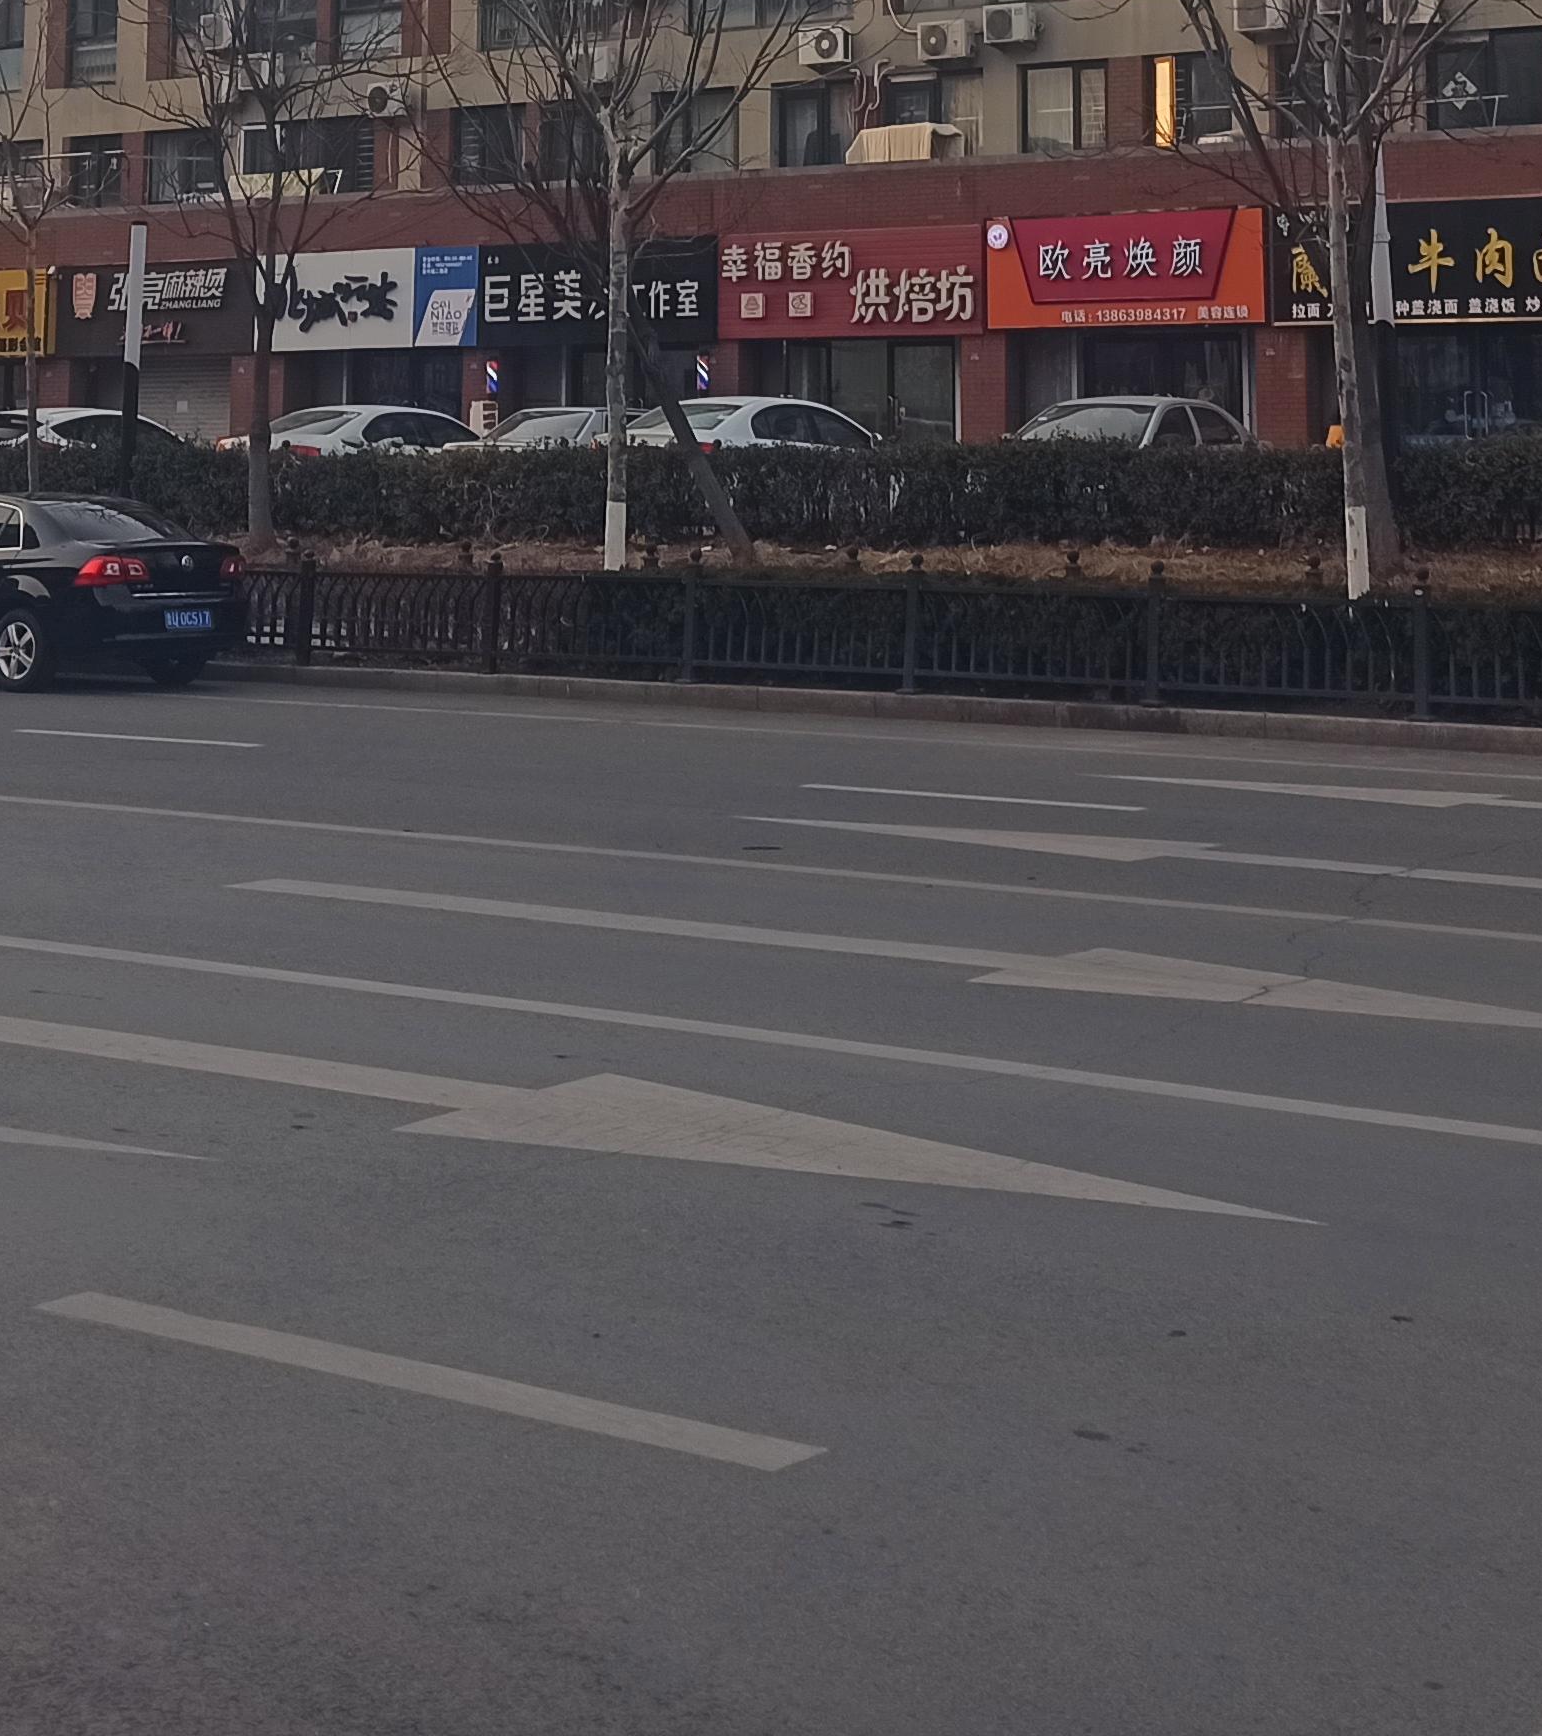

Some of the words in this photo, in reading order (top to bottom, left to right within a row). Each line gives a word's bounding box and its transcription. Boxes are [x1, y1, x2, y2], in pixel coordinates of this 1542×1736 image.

[721, 240, 851, 282] 幸福香约
[1038, 233, 1204, 281] 欧亮焕颜
[849, 265, 974, 324] 烘焙坊
